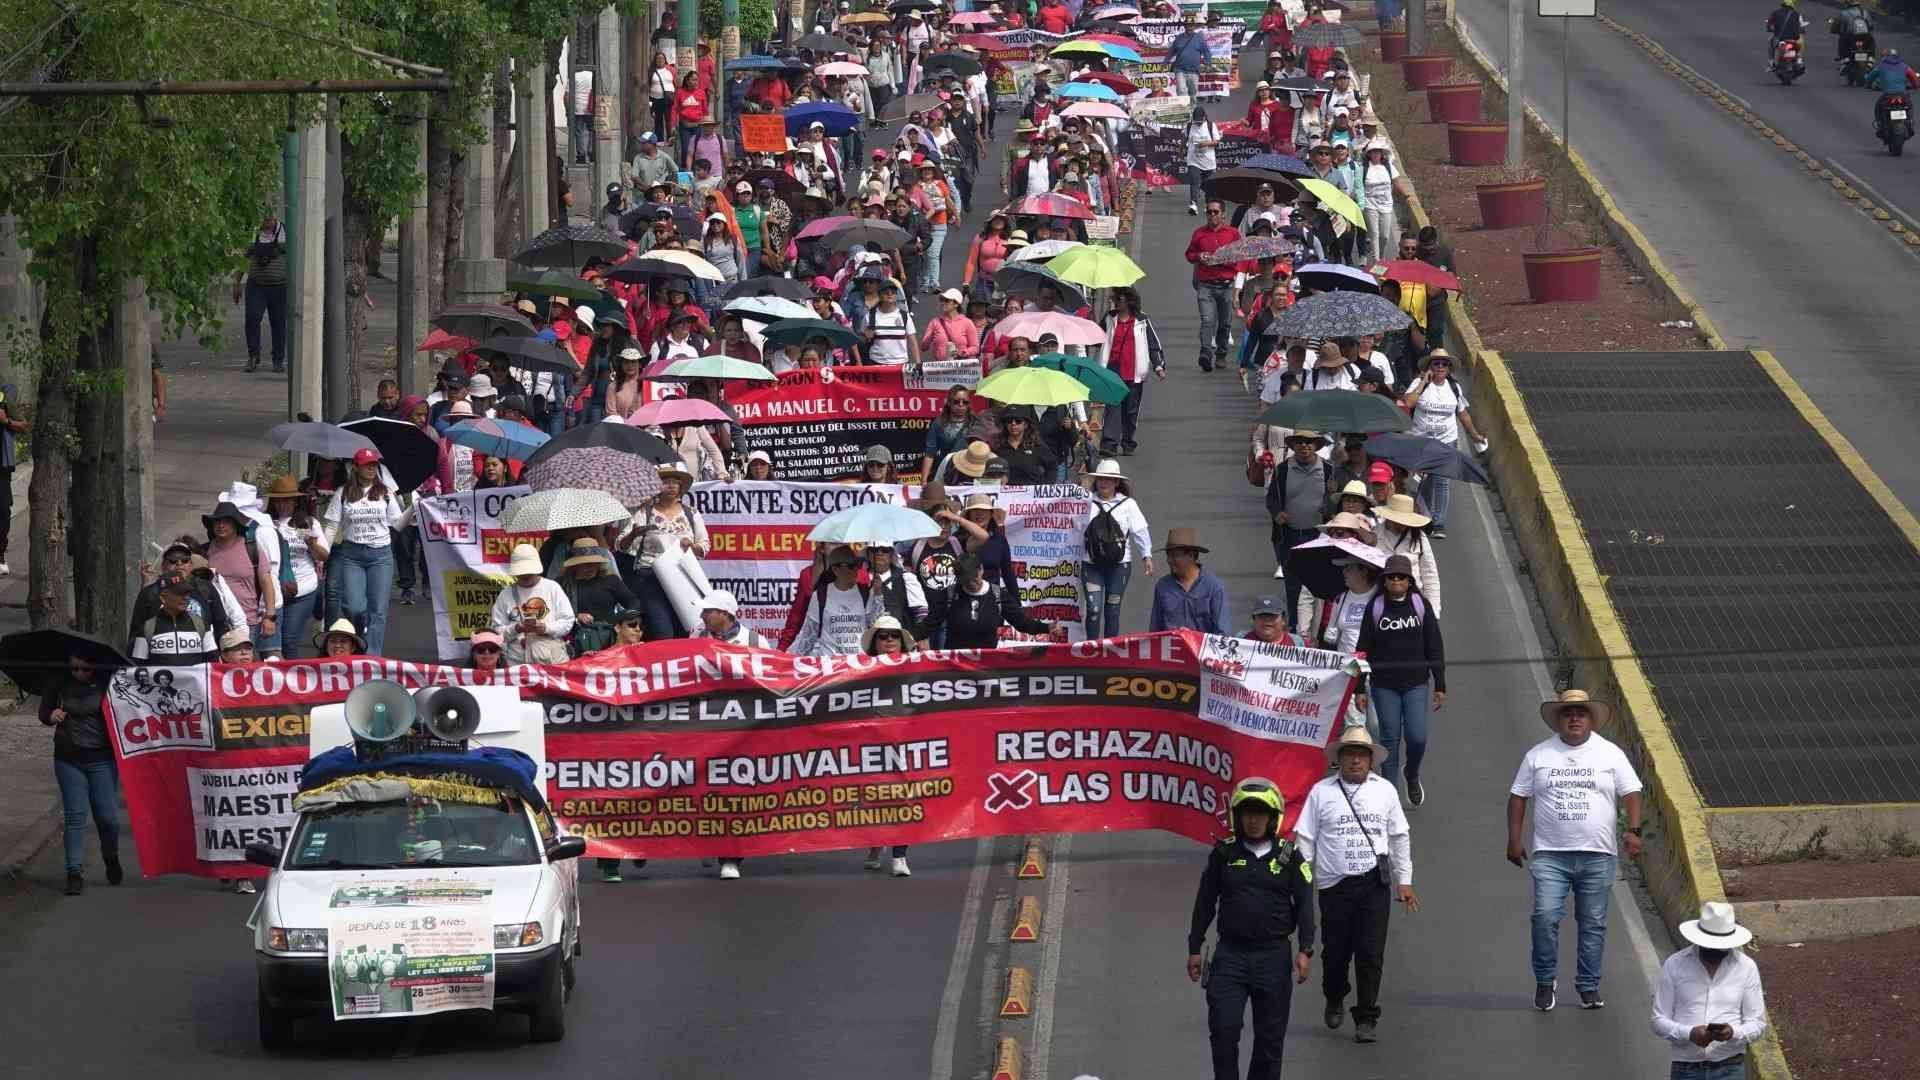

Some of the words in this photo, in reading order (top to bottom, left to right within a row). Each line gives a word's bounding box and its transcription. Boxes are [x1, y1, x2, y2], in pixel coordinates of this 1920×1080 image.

[767, 398, 839, 417] MANUEL
[843, 397, 861, 413] C.
[866, 396, 922, 412] TELLO
[782, 425, 794, 435] DE
[796, 425, 808, 434] LA
[810, 423, 826, 433] LEY
[828, 422, 845, 431] DEL
[847, 421, 879, 431] ISSSTE
[880, 421, 897, 430] DEL
[900, 419, 931, 430] 2007
[774, 438, 786, 447] DE
[788, 435, 827, 446] SERVICIO
[822, 445, 836, 455] 30
[788, 457, 823, 468] SALARIO
[824, 456, 842, 465] DEL
[1009, 501, 1045, 516] REGIÓN
[1047, 502, 1088, 515] ORIENTE
[713, 533, 737, 551] DE
[742, 532, 766, 551] LA
[774, 532, 806, 551] LEY
[745, 608, 757, 619] DE
[1380, 615, 1421, 630] Calvin
[584, 650, 779, 698] ORIENTE
[639, 703, 691, 722] DE
[699, 703, 750, 721] LA
[754, 695, 822, 720] LEY
[828, 686, 894, 713] DEL
[901, 676, 1020, 705] ISSSTE
[1028, 675, 1098, 696] DEL
[1105, 676, 1198, 704] 2007
[123, 713, 204, 744] CNTE
[707, 739, 949, 787] EQUIVALENTE
[997, 730, 1233, 782] RECHAZAMOS
[201, 769, 289, 788] JUBILACIÓN
[563, 799, 652, 817] SALARIO
[658, 797, 697, 814] DEL
[703, 793, 779, 813] ÚLTIMO
[783, 787, 826, 809] AÑO
[832, 786, 860, 803] DE
[864, 778, 953, 801] SERVICIO
[1038, 772, 1111, 804] LAS
[1122, 772, 1218, 815] UMAS
[569, 819, 692, 839] CALCULADO
[698, 819, 726, 837] EN
[731, 810, 831, 835] SALARIOS
[836, 804, 924, 827] MÍNIMOS
[394, 919, 407, 930] DE
[410, 915, 437, 931] 18
[412, 988, 424, 998] 28
